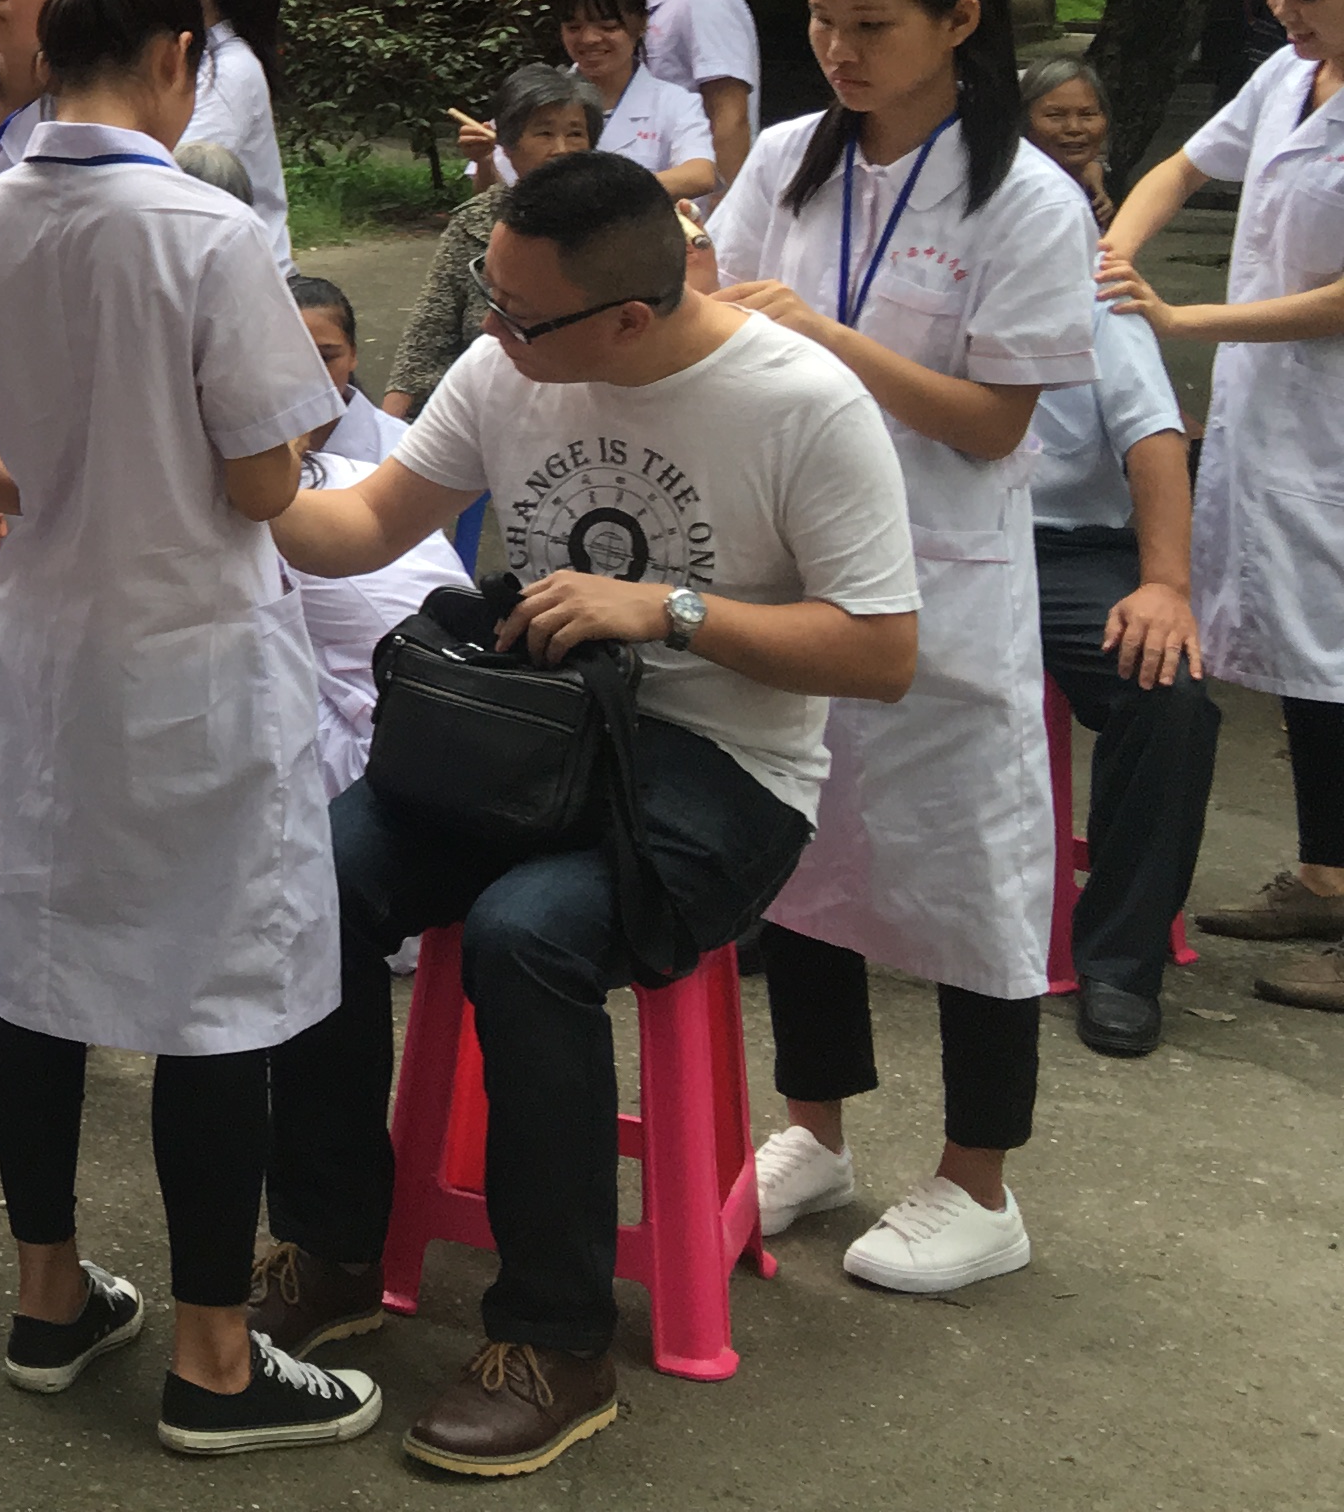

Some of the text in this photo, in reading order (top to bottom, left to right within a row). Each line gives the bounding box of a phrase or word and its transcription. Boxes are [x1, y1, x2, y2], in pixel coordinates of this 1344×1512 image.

[506, 436, 717, 587] CHANGE IS THE ONL
